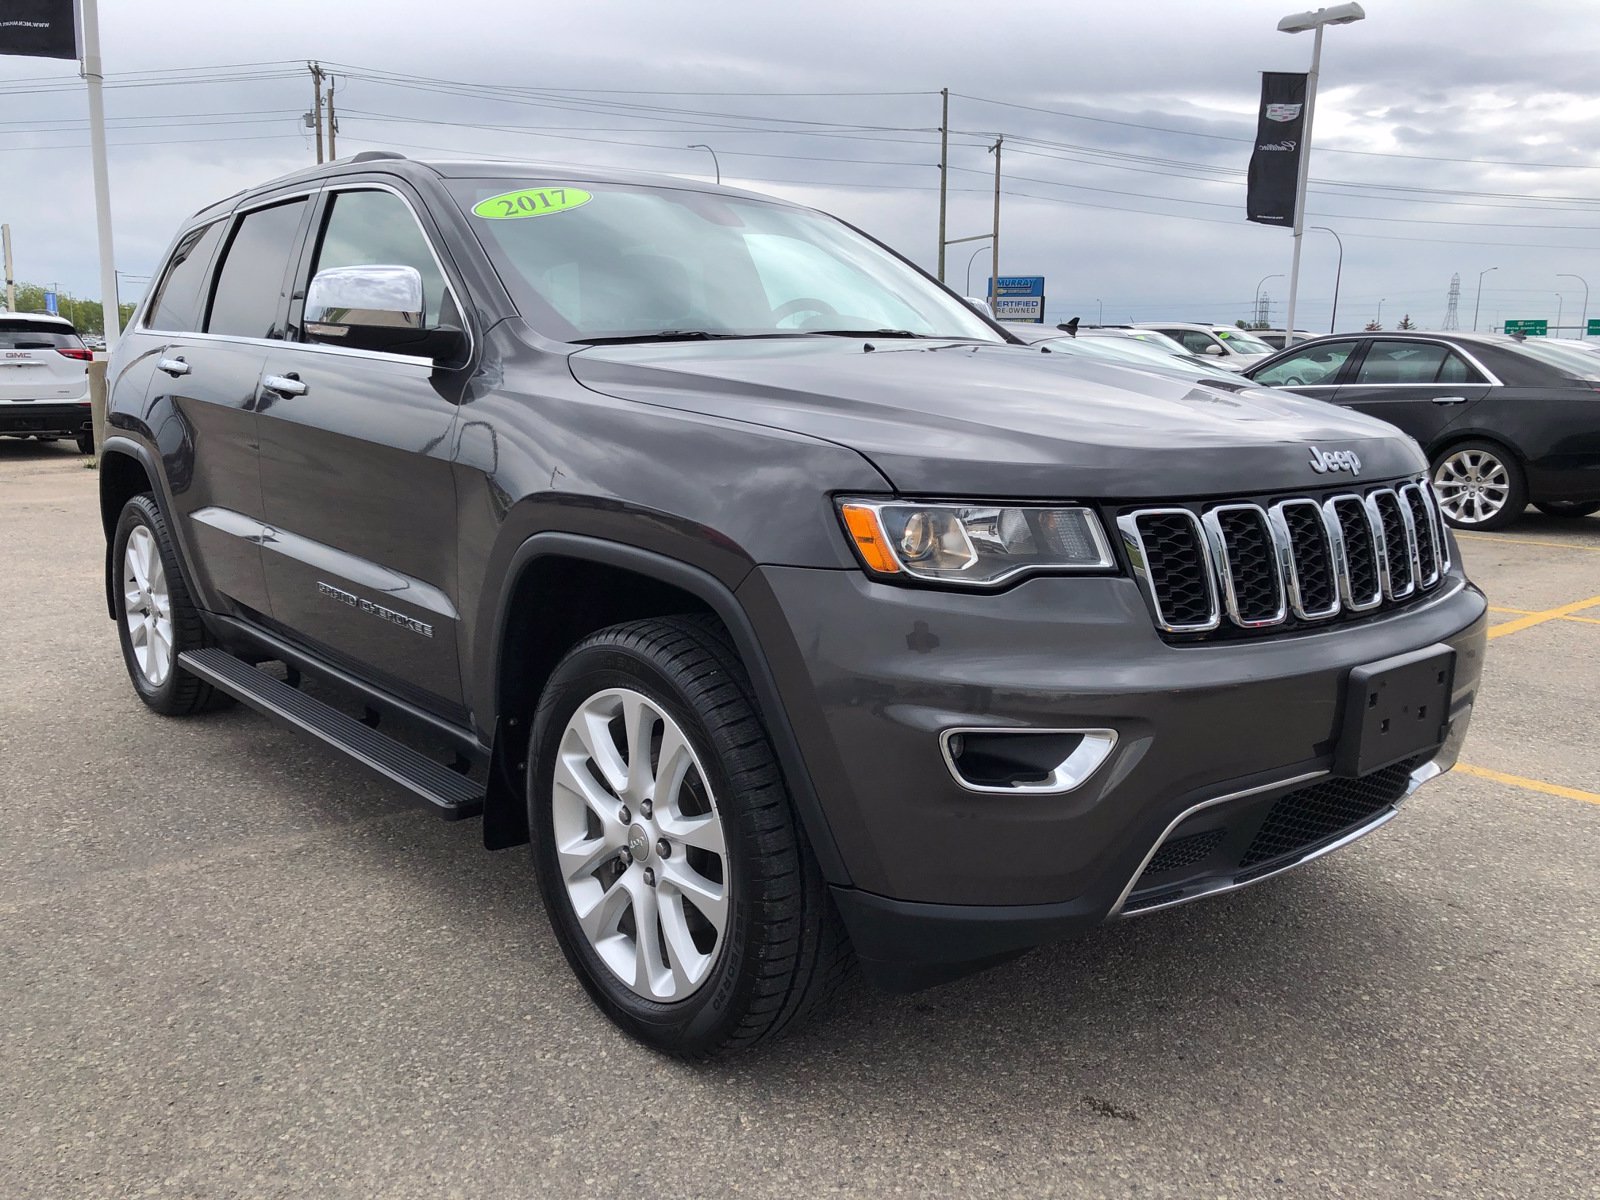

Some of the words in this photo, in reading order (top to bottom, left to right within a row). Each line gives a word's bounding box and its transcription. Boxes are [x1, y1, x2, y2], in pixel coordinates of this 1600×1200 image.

[497, 189, 567, 217] 2017
[997, 279, 1034, 288] MURRAY
[1308, 446, 1362, 477] Jeep
[360, 598, 434, 639] CHEROKEE
